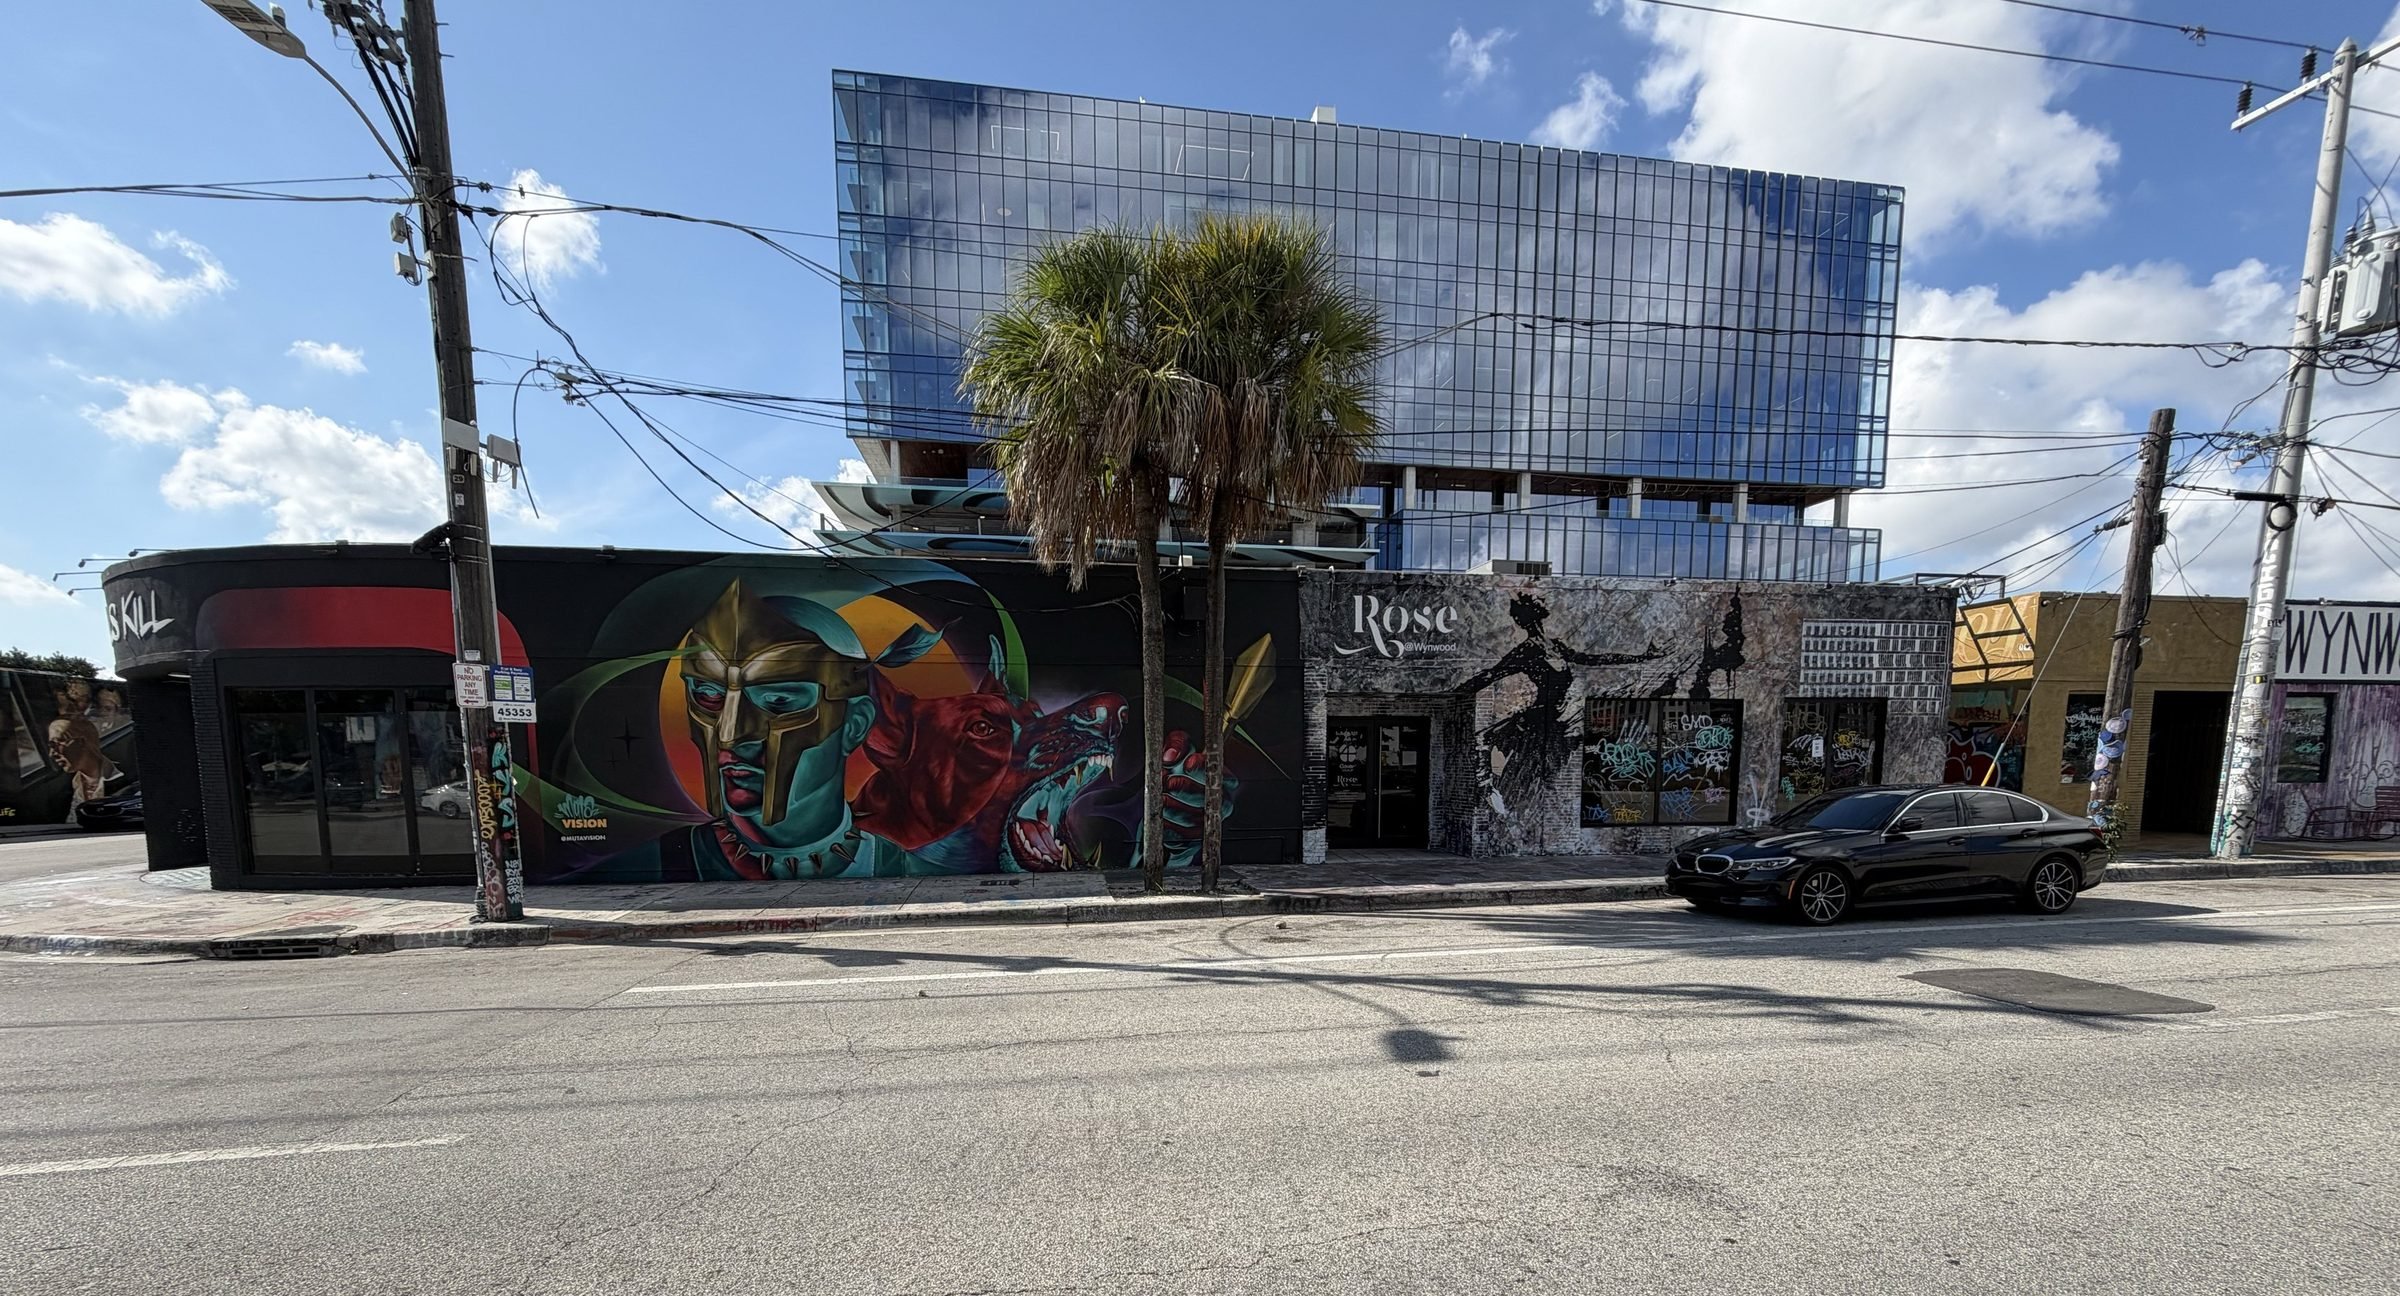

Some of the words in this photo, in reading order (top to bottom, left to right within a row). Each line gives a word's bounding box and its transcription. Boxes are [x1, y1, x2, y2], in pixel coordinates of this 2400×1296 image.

[121, 589, 175, 640] KILL
[1334, 595, 1458, 658] Rose
[1404, 642, 1457, 653] @Wynwood
[2285, 610, 2400, 675] WYNW
[457, 673, 482, 682] PARKING
[464, 688, 479, 696] TIME
[497, 707, 532, 717] 45353
[562, 818, 607, 828] VISION
[560, 834, 606, 842] @MUTAVISION
